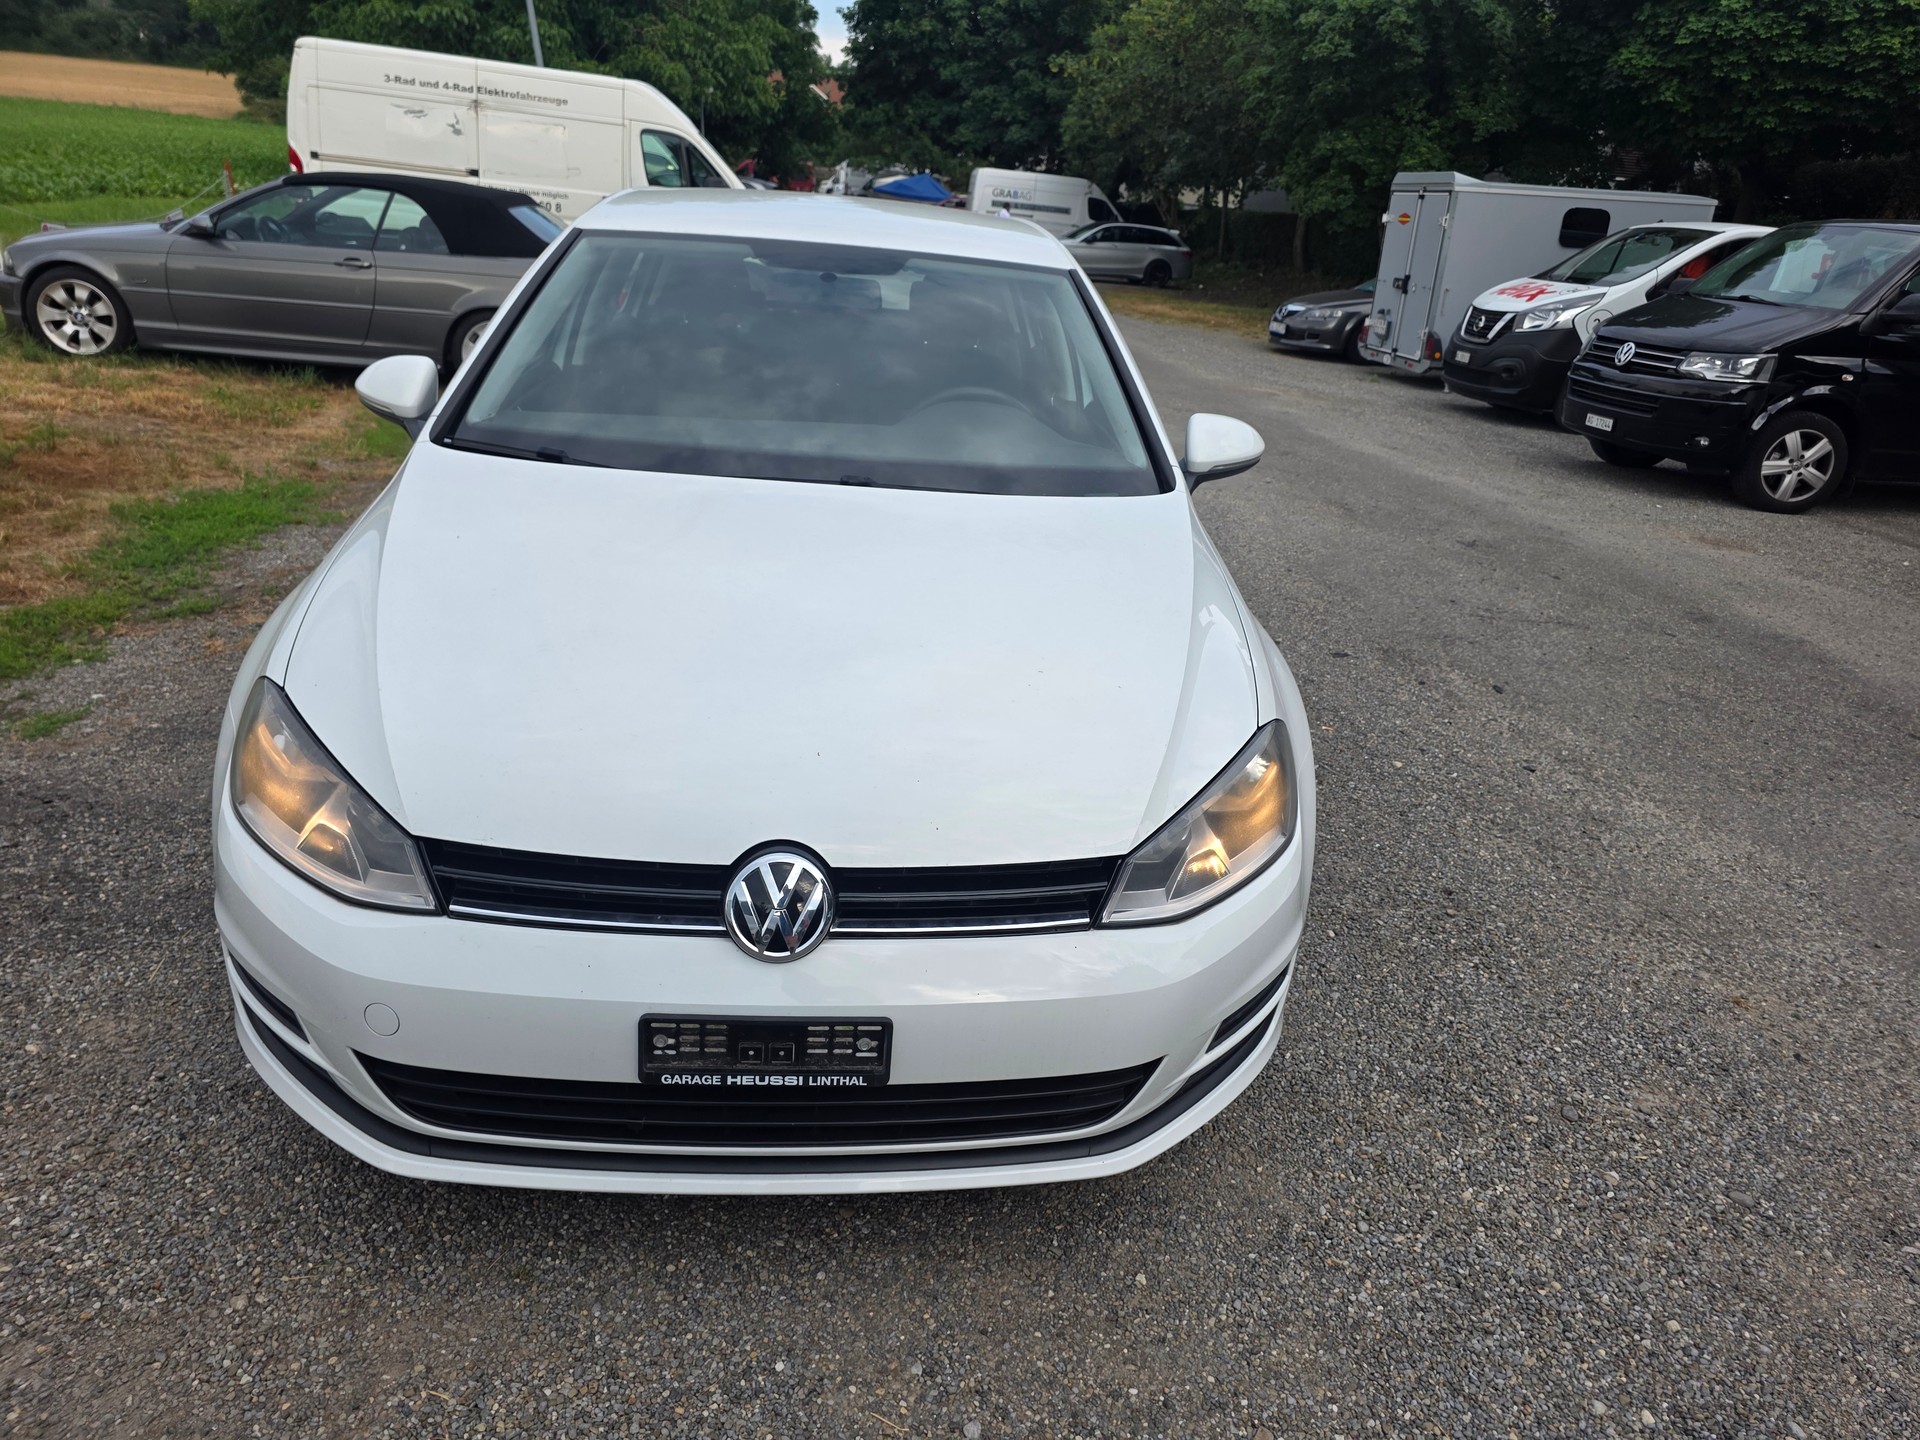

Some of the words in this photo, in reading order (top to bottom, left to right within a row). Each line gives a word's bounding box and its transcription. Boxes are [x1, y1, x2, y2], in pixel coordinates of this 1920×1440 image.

[384, 74, 416, 86] 3-Rad
[419, 77, 440, 89] und
[442, 81, 474, 94] 4-Rad
[477, 86, 569, 107] Elektrofahrzeuge
[542, 191, 569, 200] möglich
[992, 187, 1033, 201] GRABAG
[661, 1074, 722, 1085] GARAGE
[726, 1075, 804, 1086] HEUSSI
[808, 1076, 867, 1087] LINTHAL
